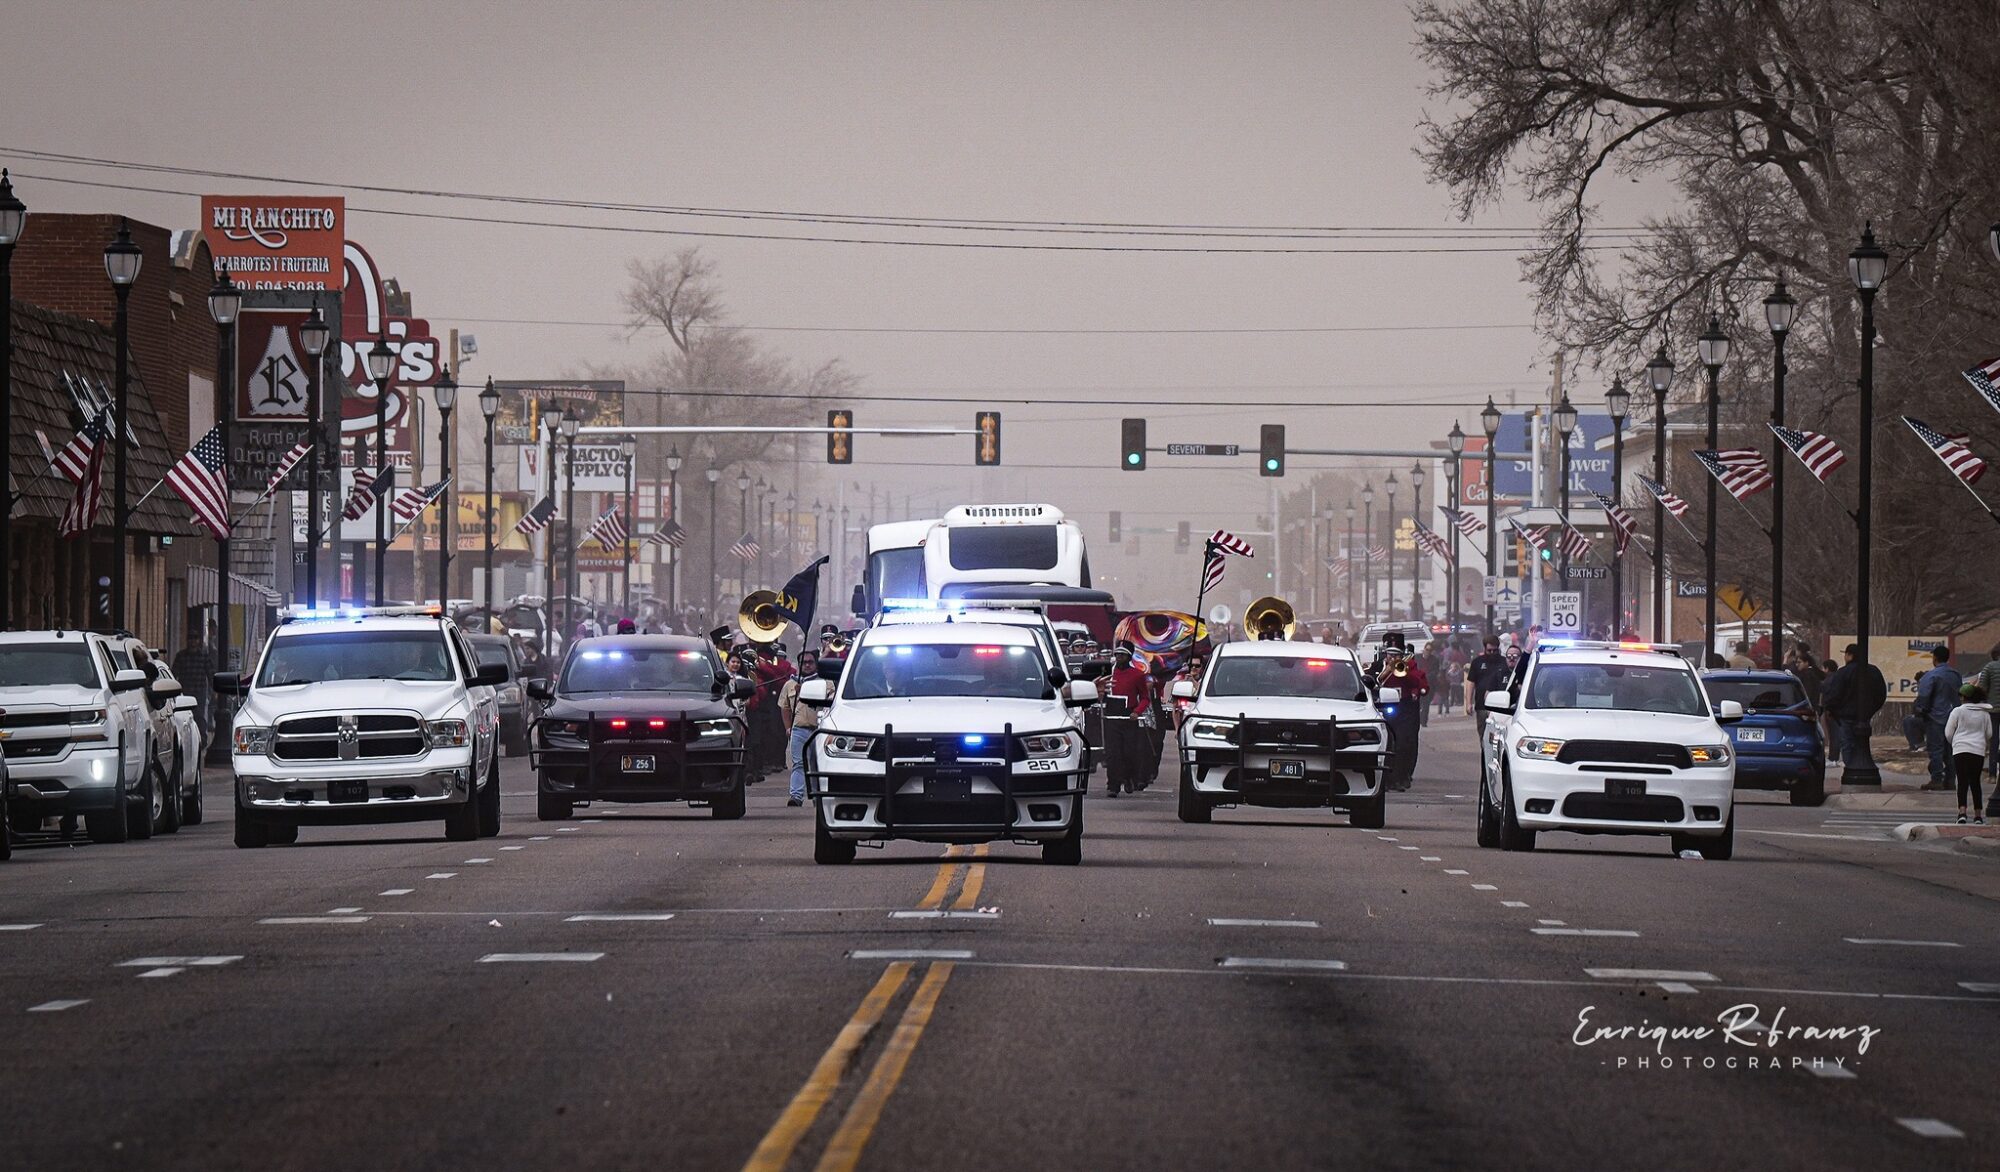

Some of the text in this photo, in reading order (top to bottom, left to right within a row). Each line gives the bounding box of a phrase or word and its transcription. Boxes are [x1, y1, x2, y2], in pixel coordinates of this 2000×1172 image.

[213, 207, 335, 246] MI RANCHITO
[272, 257, 279, 272] Y
[281, 257, 330, 273] FRUTERIA
[1169, 444, 1237, 455] SEVENTH ST
[366, 453, 412, 467] SPRITS
[1568, 568, 1605, 578] SIXTH ST
[1551, 595, 1578, 603] SPEED
[1552, 612, 1577, 627] 30
[1907, 639, 1945, 649] Liberal
[635, 759, 649, 769] 256
[1027, 760, 1059, 771] 251
[1284, 765, 1297, 775] 481
